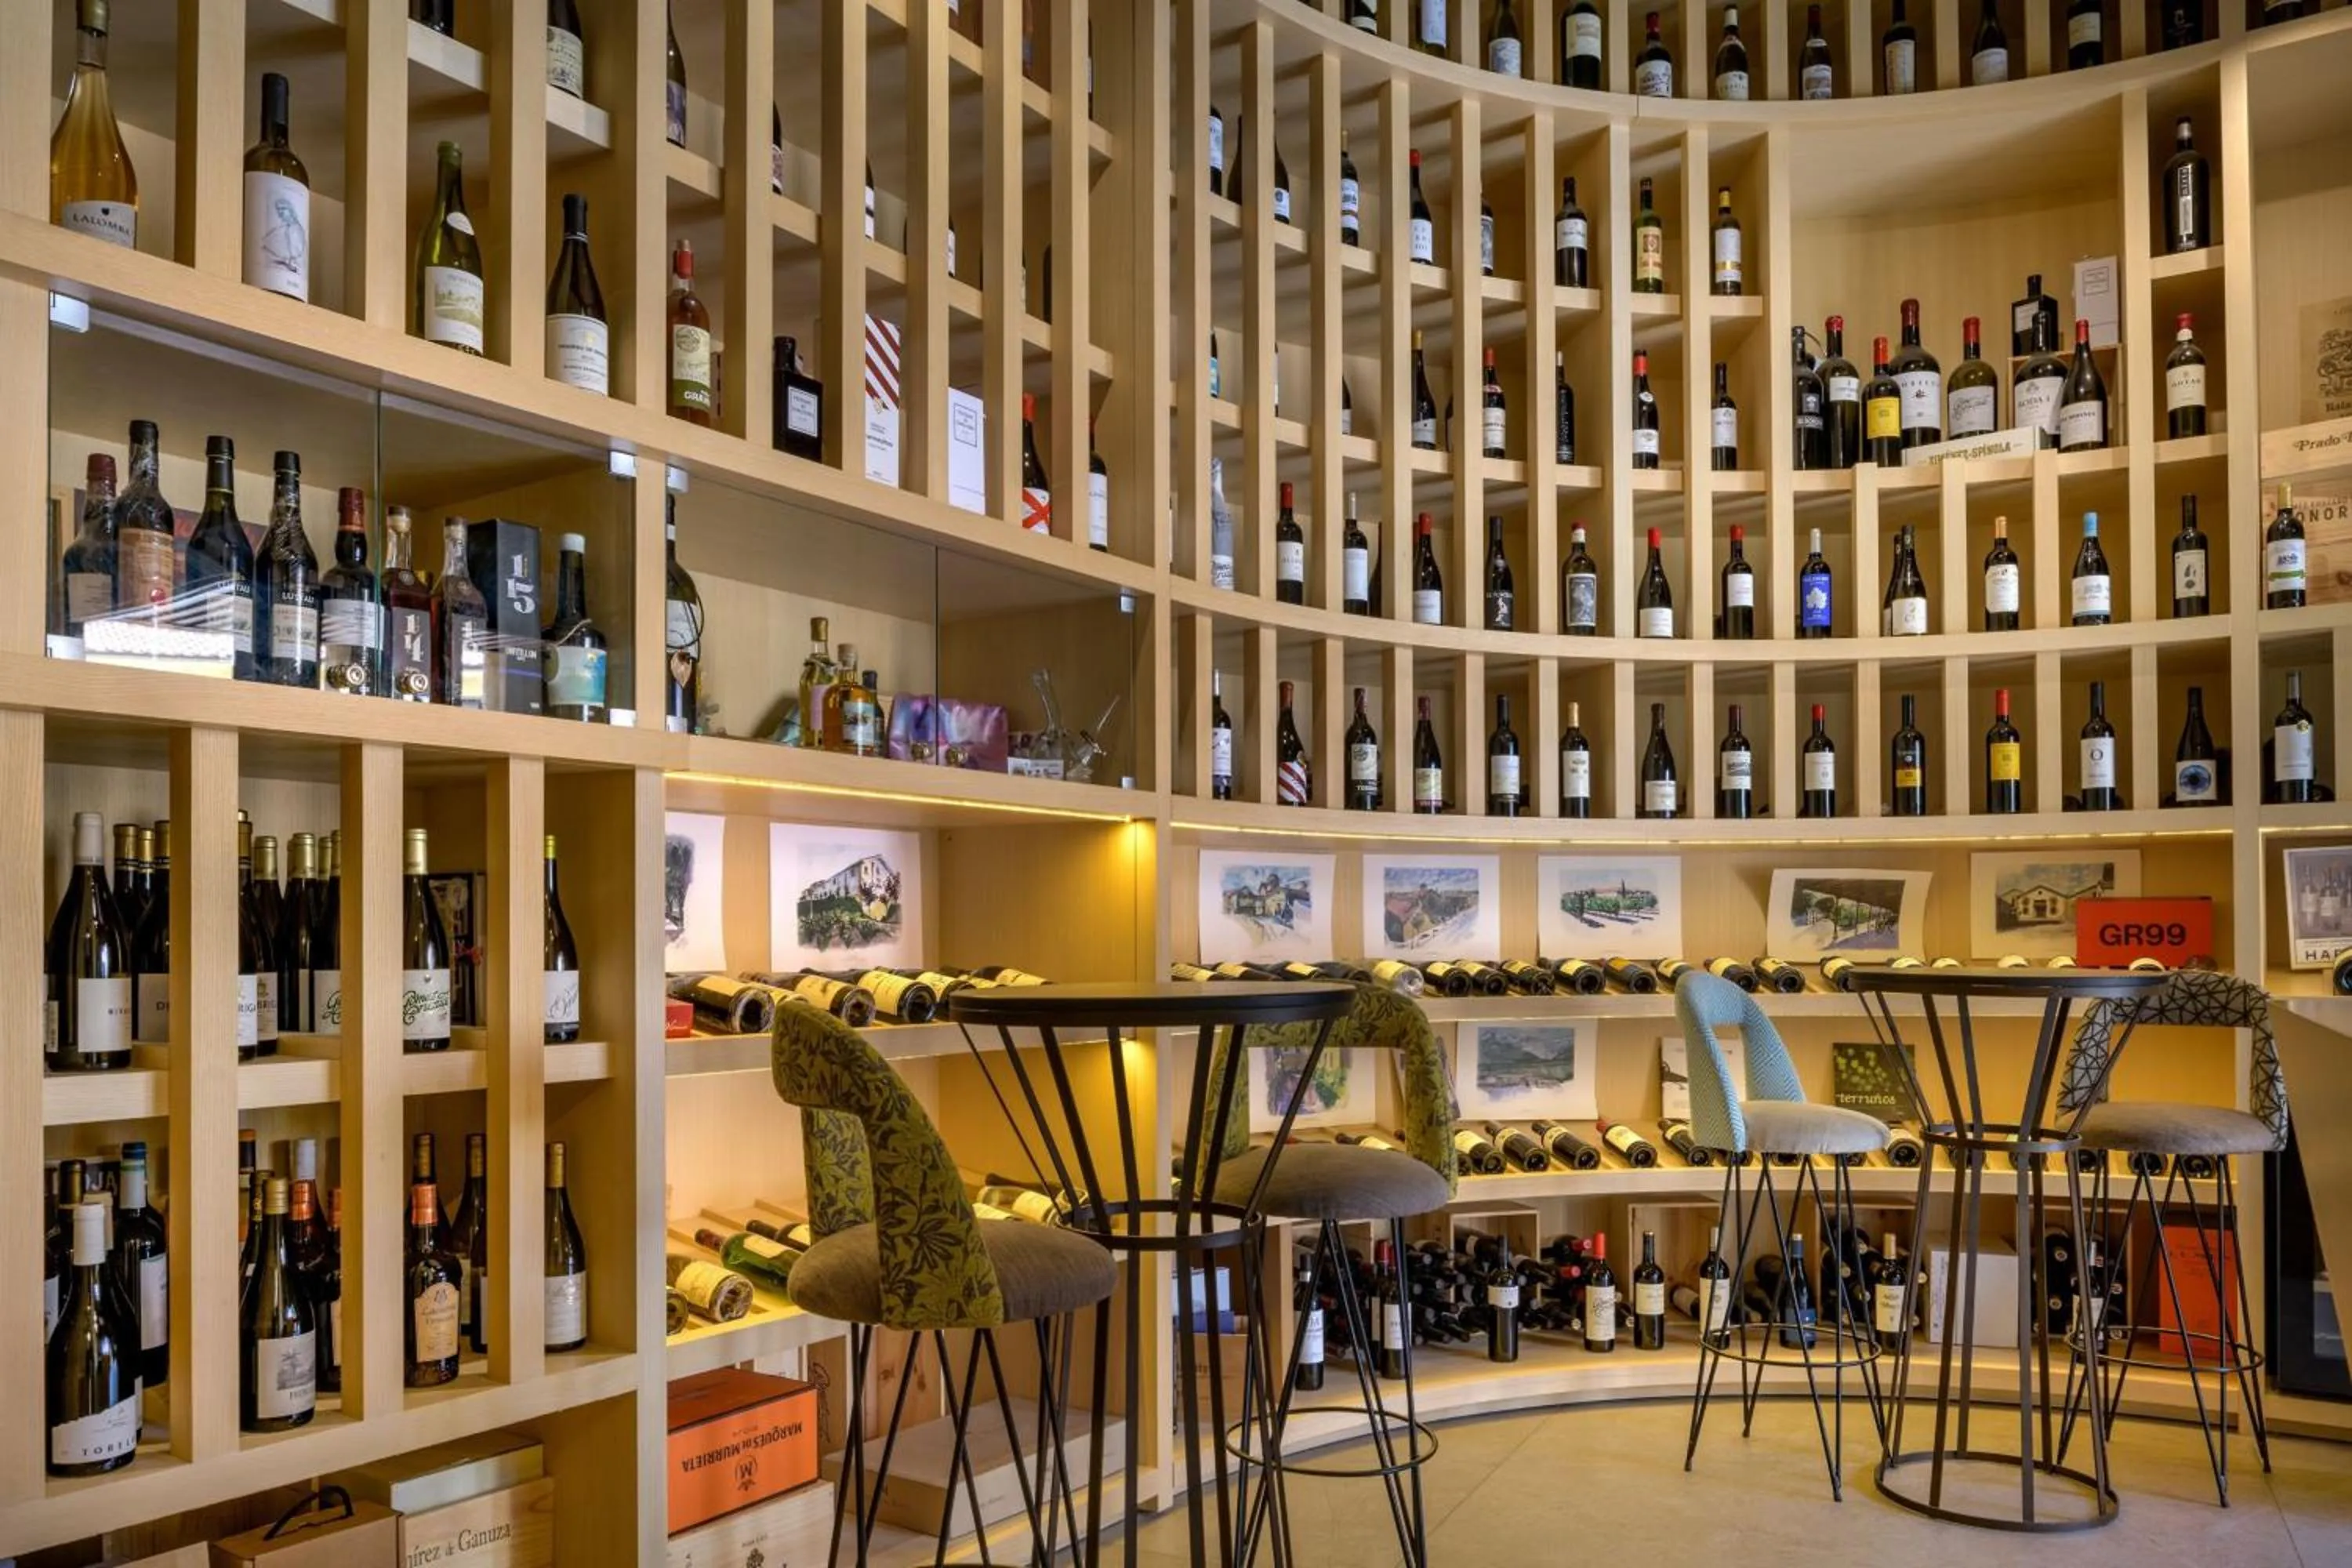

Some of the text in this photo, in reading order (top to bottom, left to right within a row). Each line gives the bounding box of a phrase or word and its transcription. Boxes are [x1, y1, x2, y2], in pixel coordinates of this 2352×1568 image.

[2292, 434, 2340, 452] Prado
[2295, 506, 2348, 523] ONOR
[2099, 923, 2187, 946] GR99
[681, 1443, 741, 1473] MURRIETA
[458, 1523, 512, 1552] Ganuza
